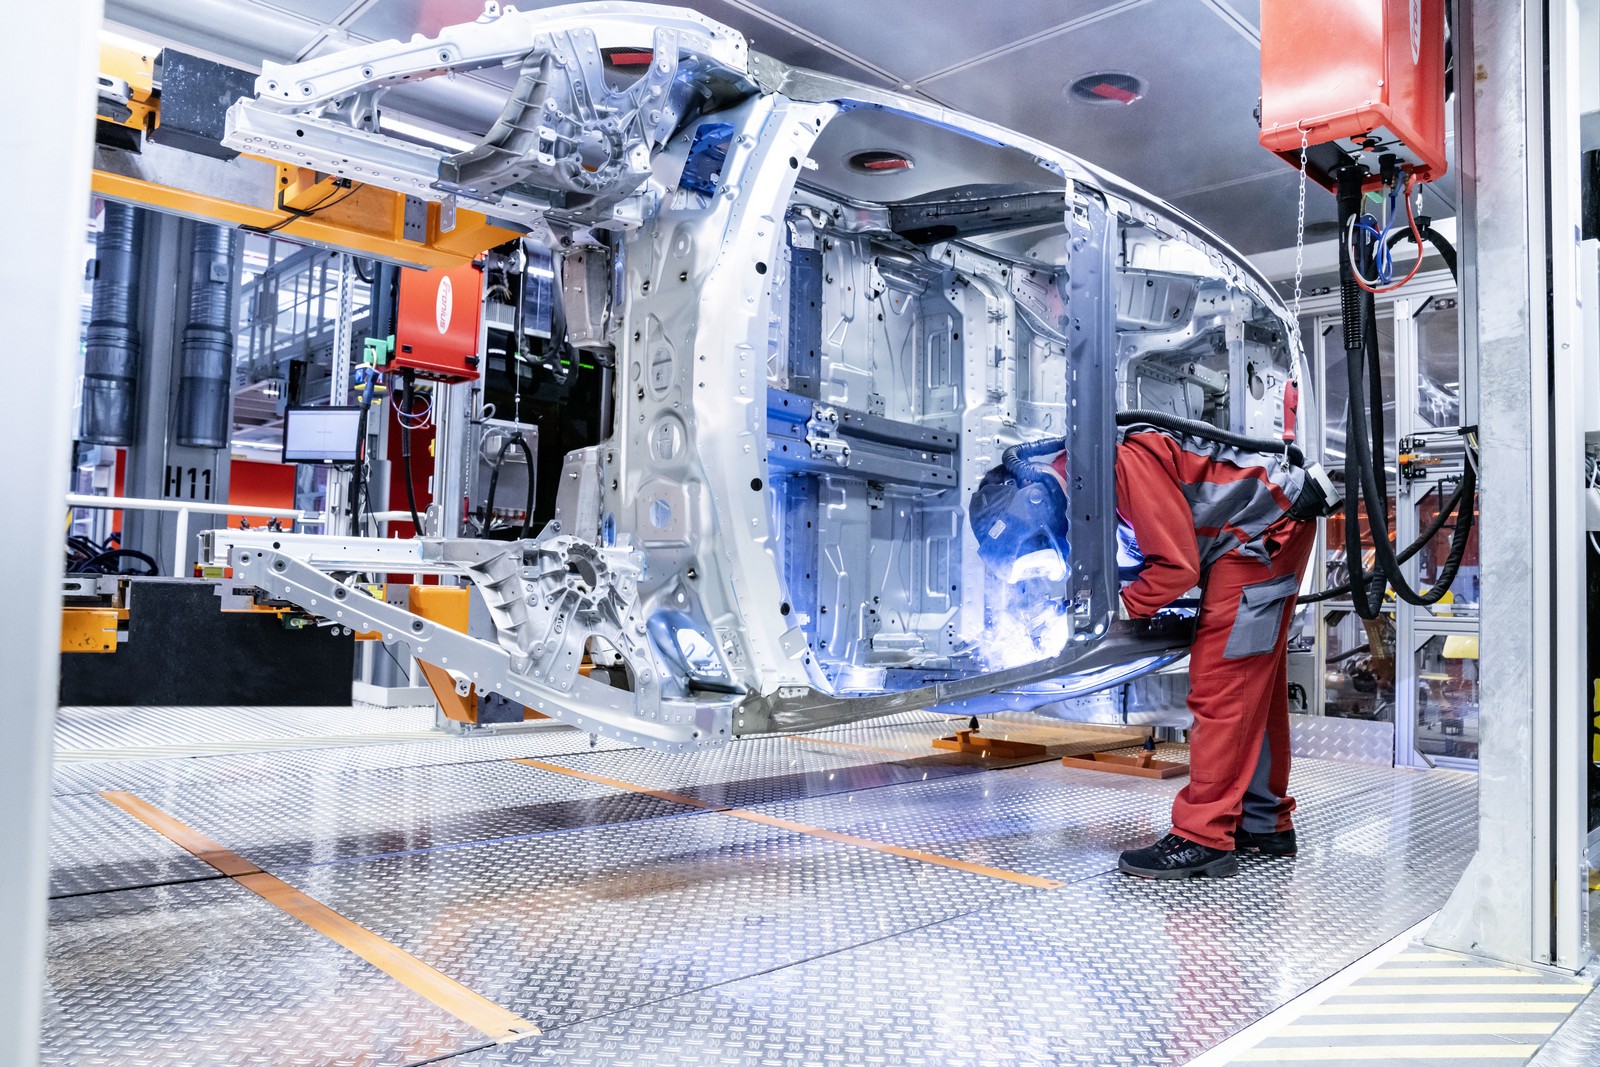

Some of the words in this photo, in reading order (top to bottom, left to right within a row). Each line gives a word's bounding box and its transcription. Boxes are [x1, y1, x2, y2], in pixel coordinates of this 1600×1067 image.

[439, 281, 451, 330] Fronius
[165, 465, 211, 500] H11
[1160, 845, 1212, 870] uvex
